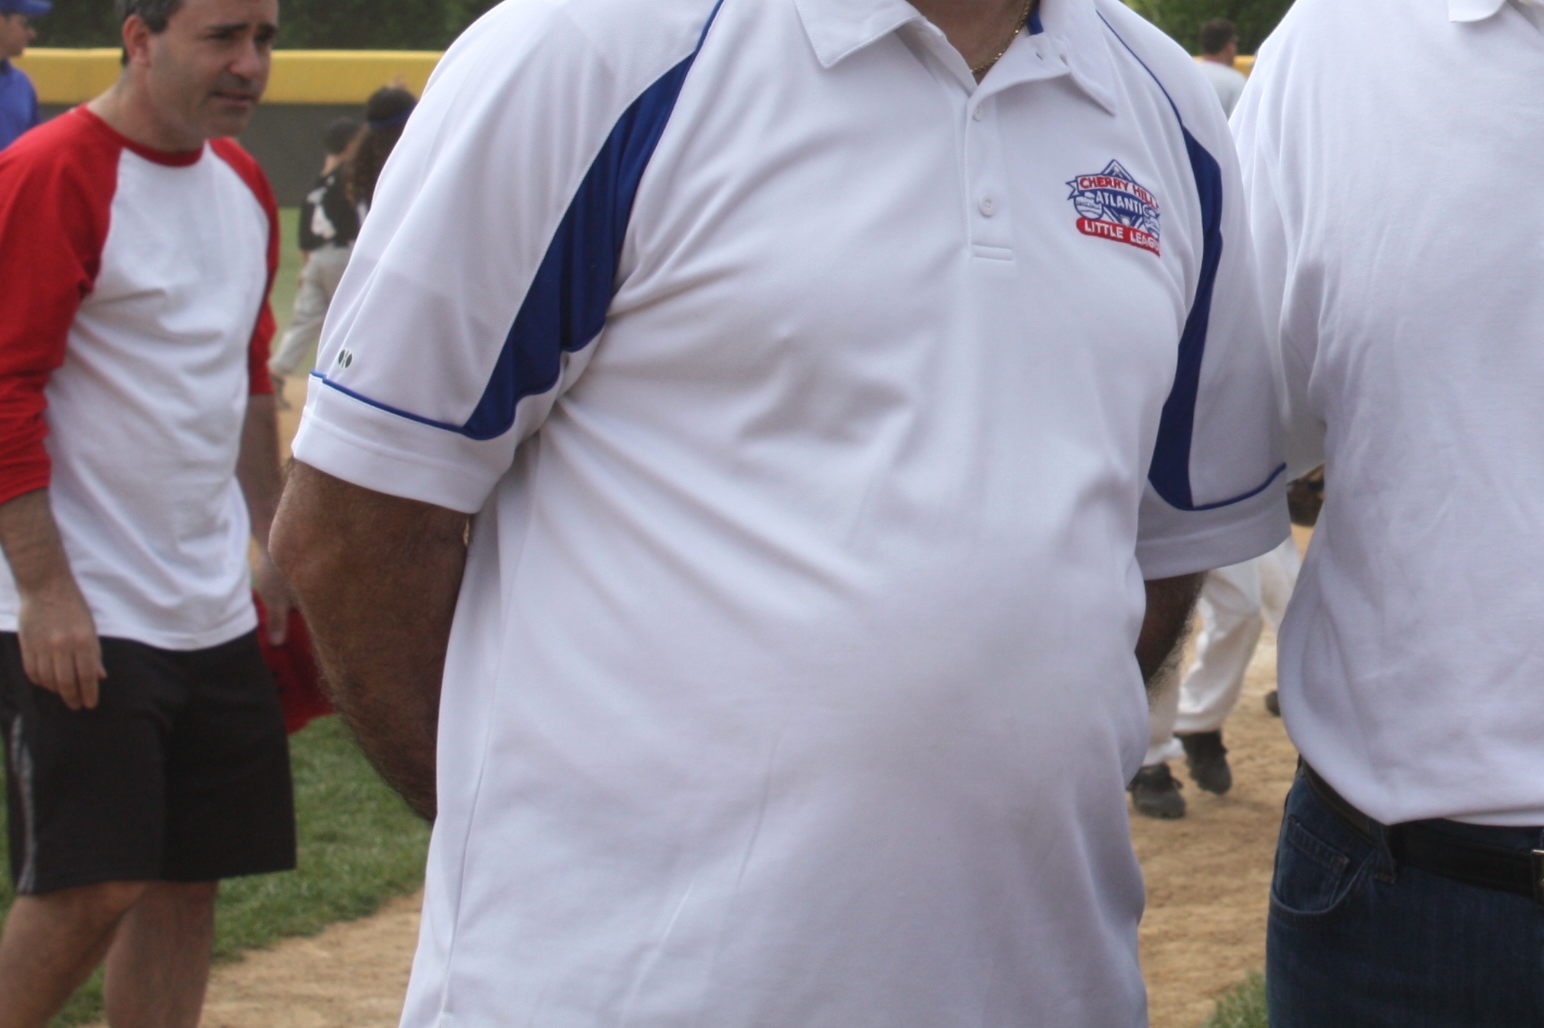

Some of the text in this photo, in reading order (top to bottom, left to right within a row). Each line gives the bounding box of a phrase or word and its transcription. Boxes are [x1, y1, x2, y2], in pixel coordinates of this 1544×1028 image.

[1079, 175, 1158, 209] CHERRY HILL
[1095, 191, 1154, 218] ATLANTIC
[1084, 219, 1124, 239] LITTLE
